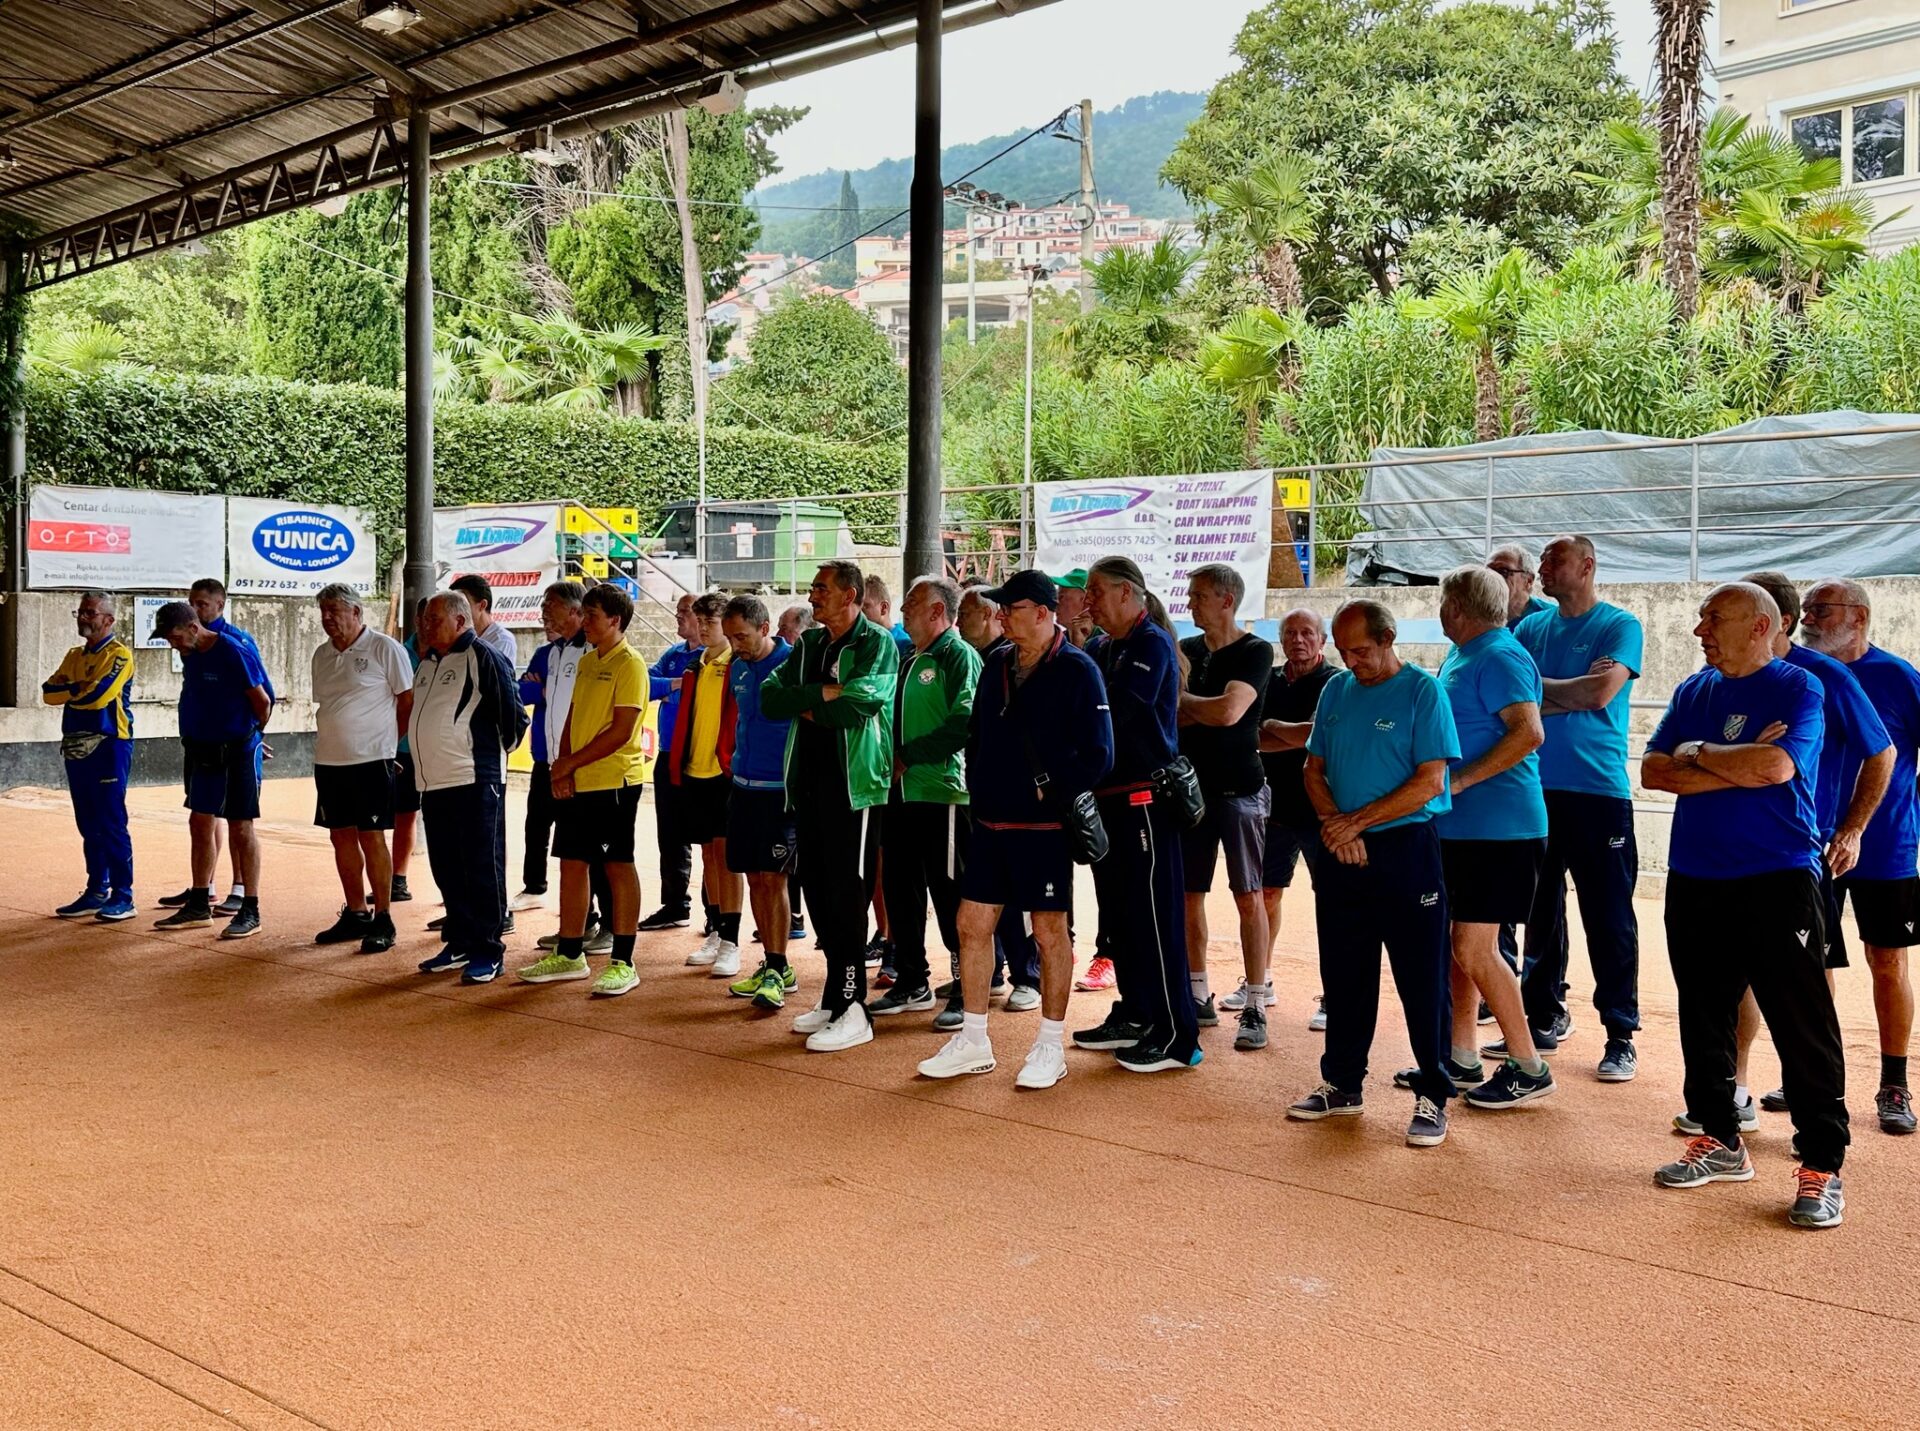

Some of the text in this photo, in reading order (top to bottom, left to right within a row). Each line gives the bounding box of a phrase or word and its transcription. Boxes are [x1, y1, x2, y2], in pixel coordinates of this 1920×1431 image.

[1175, 480, 1226, 493] XXL PRINT
[63, 501, 98, 512] Centar
[1175, 495, 1258, 510] BOAT WRAPPING
[276, 514, 333, 530] RIBARNICE
[1174, 514, 1252, 528] CAR WRAPPING
[260, 529, 348, 551] TUNICA
[1174, 531, 1257, 545] REKLAMNE TABLE
[269, 552, 339, 567] OPATIJA LOVRAN
[1191, 550, 1237, 563] REKLAME
[236, 579, 254, 588] 051
[257, 580, 276, 588] 272
[279, 581, 298, 589] 632
